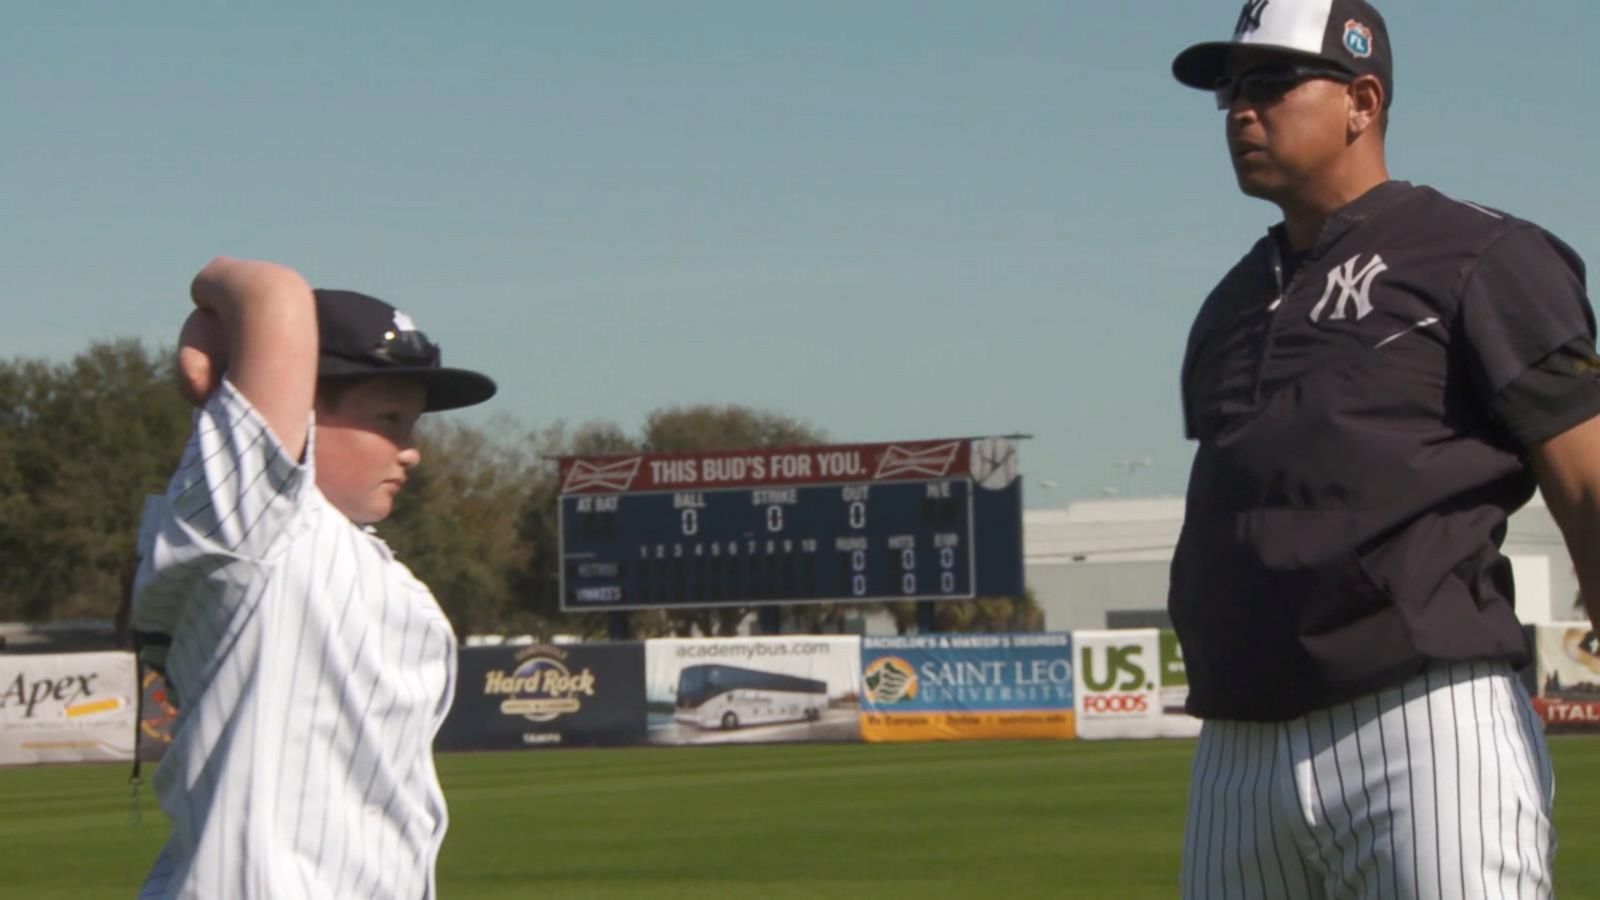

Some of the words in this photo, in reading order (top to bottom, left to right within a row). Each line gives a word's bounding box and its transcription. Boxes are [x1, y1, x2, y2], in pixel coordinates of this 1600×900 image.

[1349, 32, 1366, 50] FL
[1309, 253, 1388, 323] NY
[651, 460, 698, 483] THIS
[702, 456, 765, 481] BUD'S
[771, 453, 812, 478] FOR
[817, 451, 867, 476] YOU.
[576, 497, 592, 512] AT
[595, 496, 619, 511] BAT
[673, 493, 706, 508] BALL
[752, 489, 797, 504] STRIKE
[842, 486, 869, 501] OUT
[682, 509, 697, 535] 0
[767, 505, 783, 531] 0
[850, 502, 865, 528] 0
[641, 546, 647, 557] 1
[656, 545, 664, 557] 2
[674, 544, 682, 557] 3
[694, 543, 703, 556] 4
[711, 542, 720, 556] 5
[747, 541, 755, 554] 7
[766, 541, 774, 554] 8
[784, 540, 792, 553] 9
[802, 540, 817, 552] 10
[853, 550, 865, 571] 0
[903, 549, 915, 570] 0
[941, 548, 953, 568] 0
[853, 574, 866, 595] 0
[903, 573, 915, 594] 0
[941, 572, 954, 593] 0
[676, 641, 830, 659] academybus.com
[484, 669, 541, 694] Hard
[542, 667, 595, 696] Rock
[921, 661, 1005, 685] SAINT
[1014, 659, 1072, 684] LEO
[0, 672, 99, 718] Apex
[1083, 695, 1149, 713] FOODS
